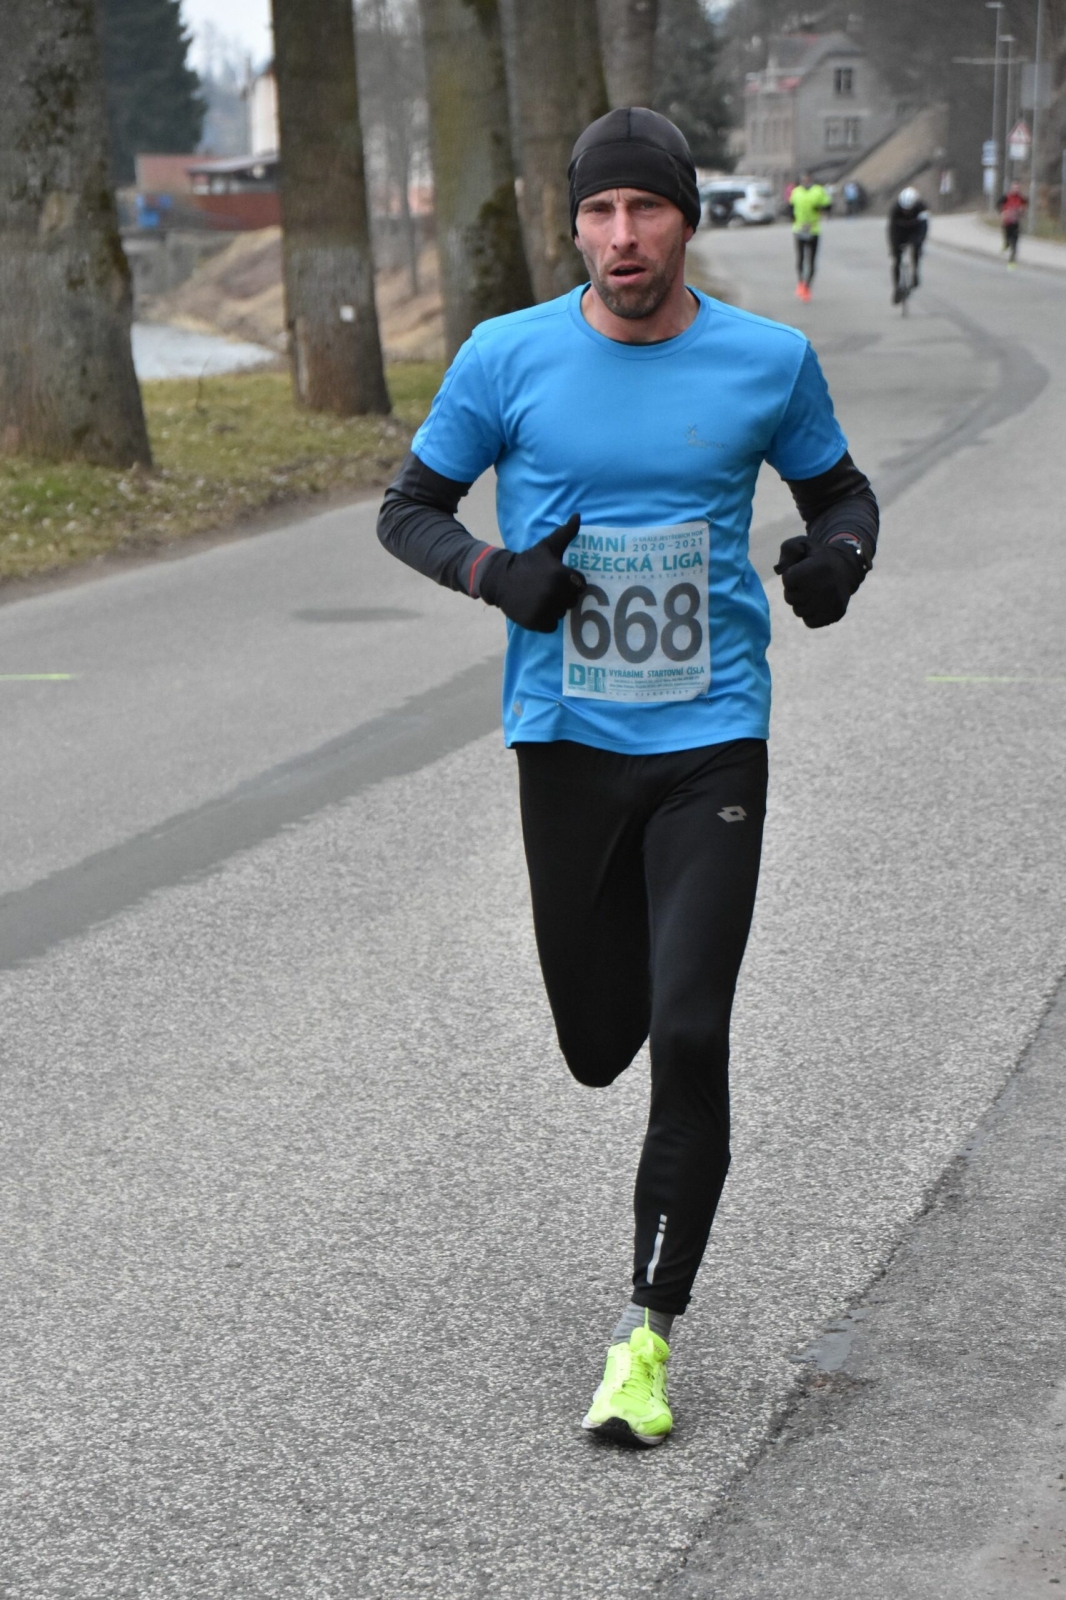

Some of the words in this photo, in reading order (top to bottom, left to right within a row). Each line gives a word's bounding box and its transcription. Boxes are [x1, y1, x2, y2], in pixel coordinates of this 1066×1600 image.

[569, 533, 627, 552] ZIMNÍ
[567, 551, 653, 572] BĚŽECKÁ
[662, 551, 703, 571] LIGA
[570, 582, 703, 664] 668
[609, 669, 644, 678] VYRÁBÍME
[647, 666, 684, 678] STARTOVNÍ
[686, 665, 705, 675] ČÍSLA
